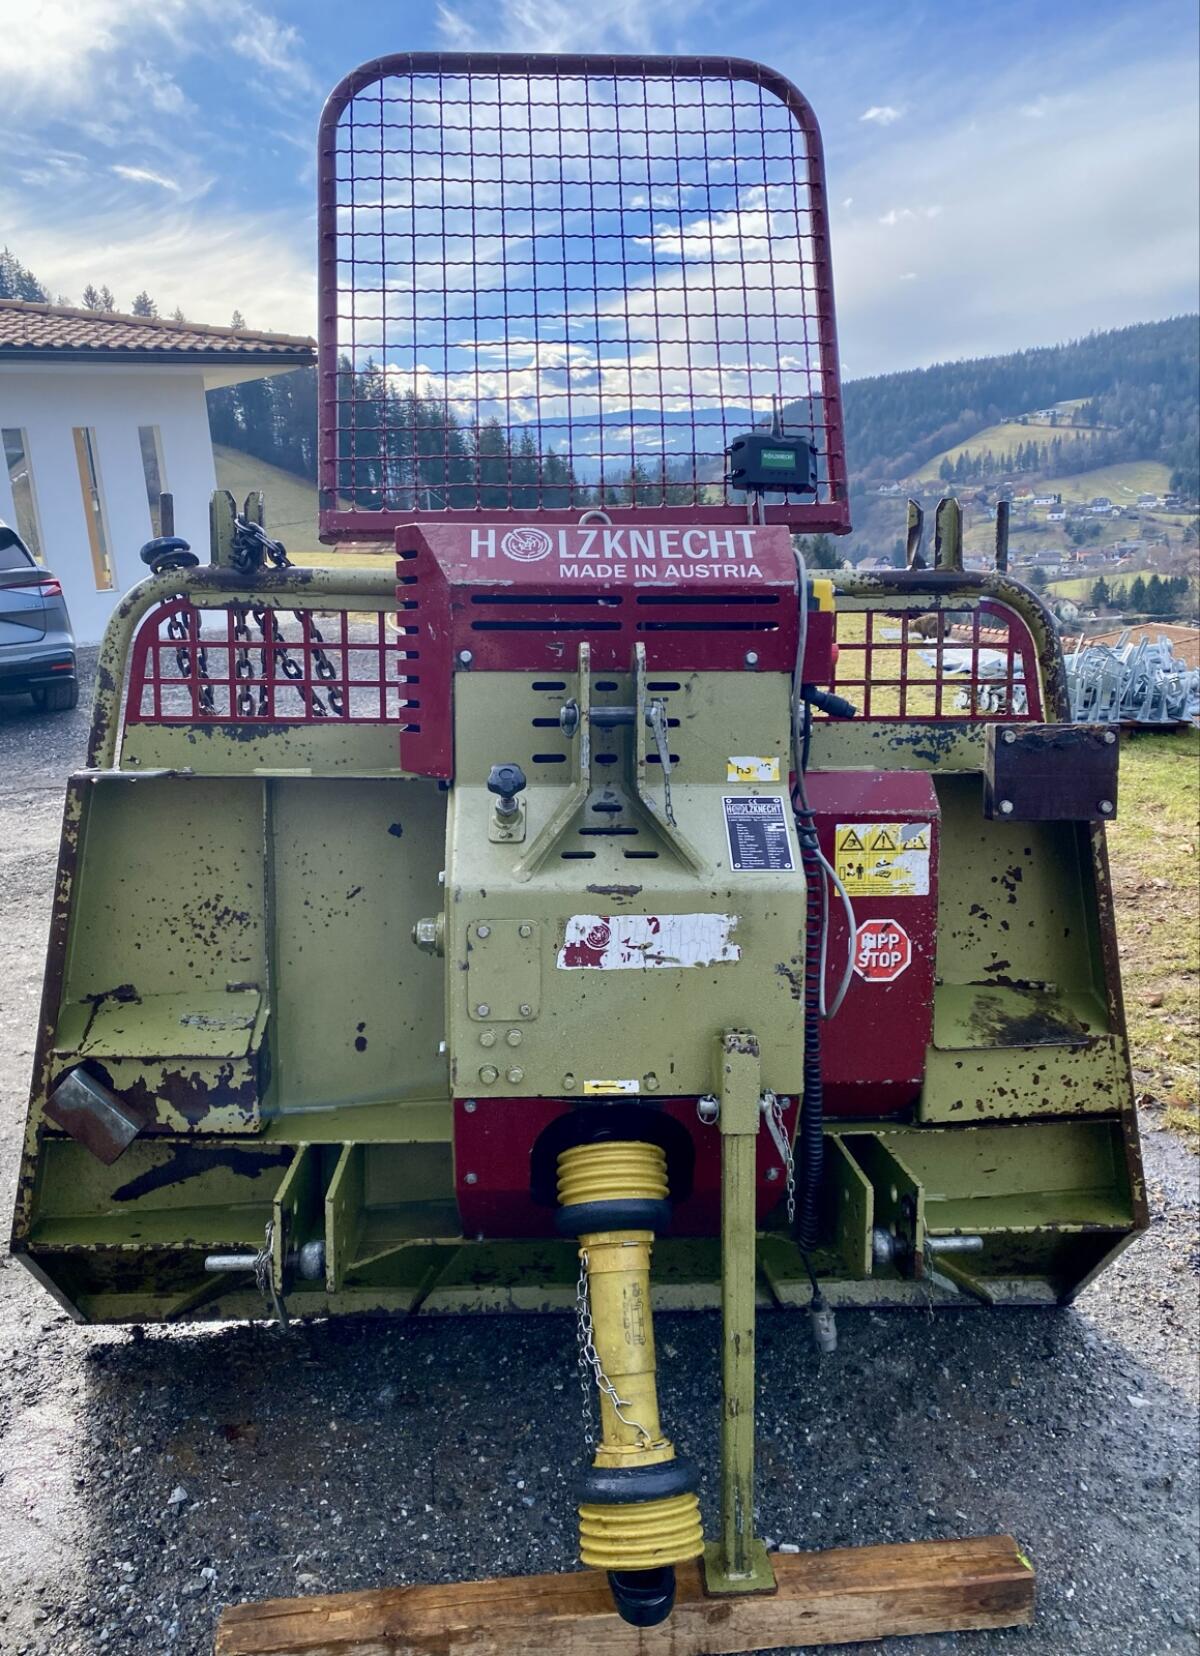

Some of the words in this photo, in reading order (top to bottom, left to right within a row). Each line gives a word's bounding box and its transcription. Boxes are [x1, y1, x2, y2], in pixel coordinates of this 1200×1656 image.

[559, 564, 627, 578] MADE
[635, 564, 656, 578] IN
[665, 564, 763, 578] AUSTRIA
[858, 951, 902, 968] STOP
